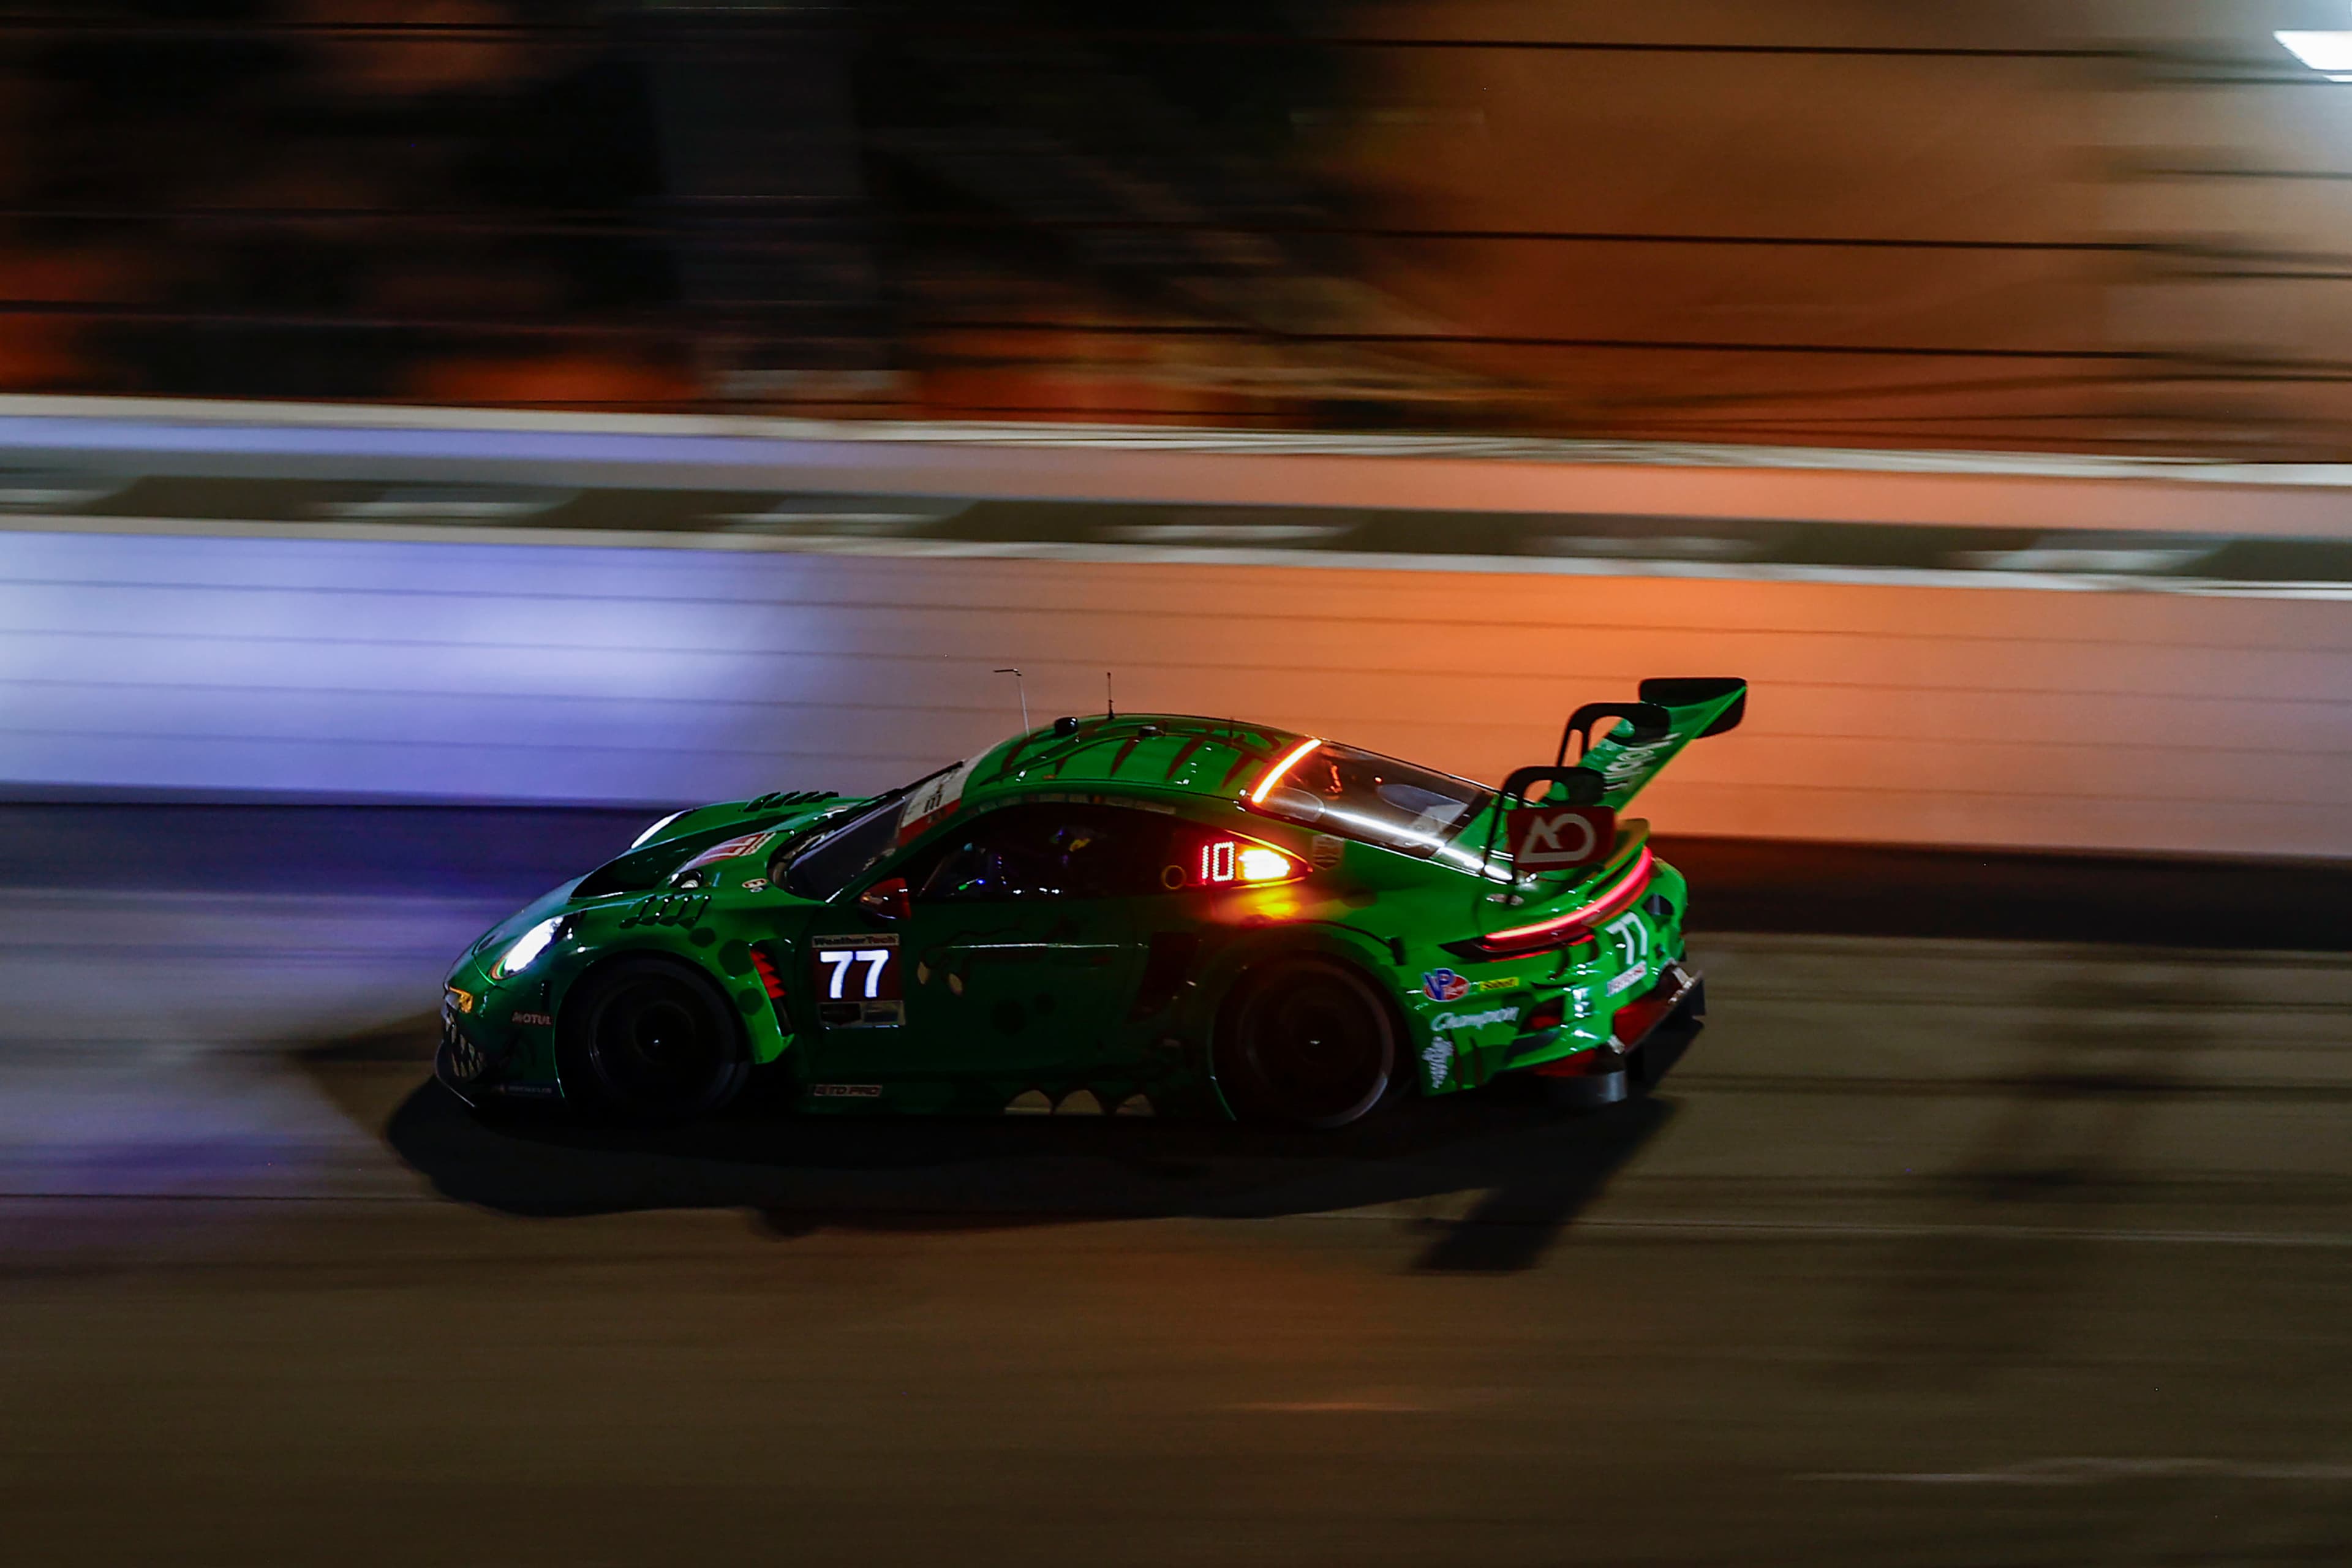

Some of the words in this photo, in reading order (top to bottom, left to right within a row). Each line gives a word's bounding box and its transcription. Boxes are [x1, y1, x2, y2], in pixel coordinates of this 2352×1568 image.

[1201, 840, 1236, 883] 10
[1605, 911, 1648, 965] 77
[819, 949, 890, 1000] 77
[511, 1010, 552, 1026] MOTUL
